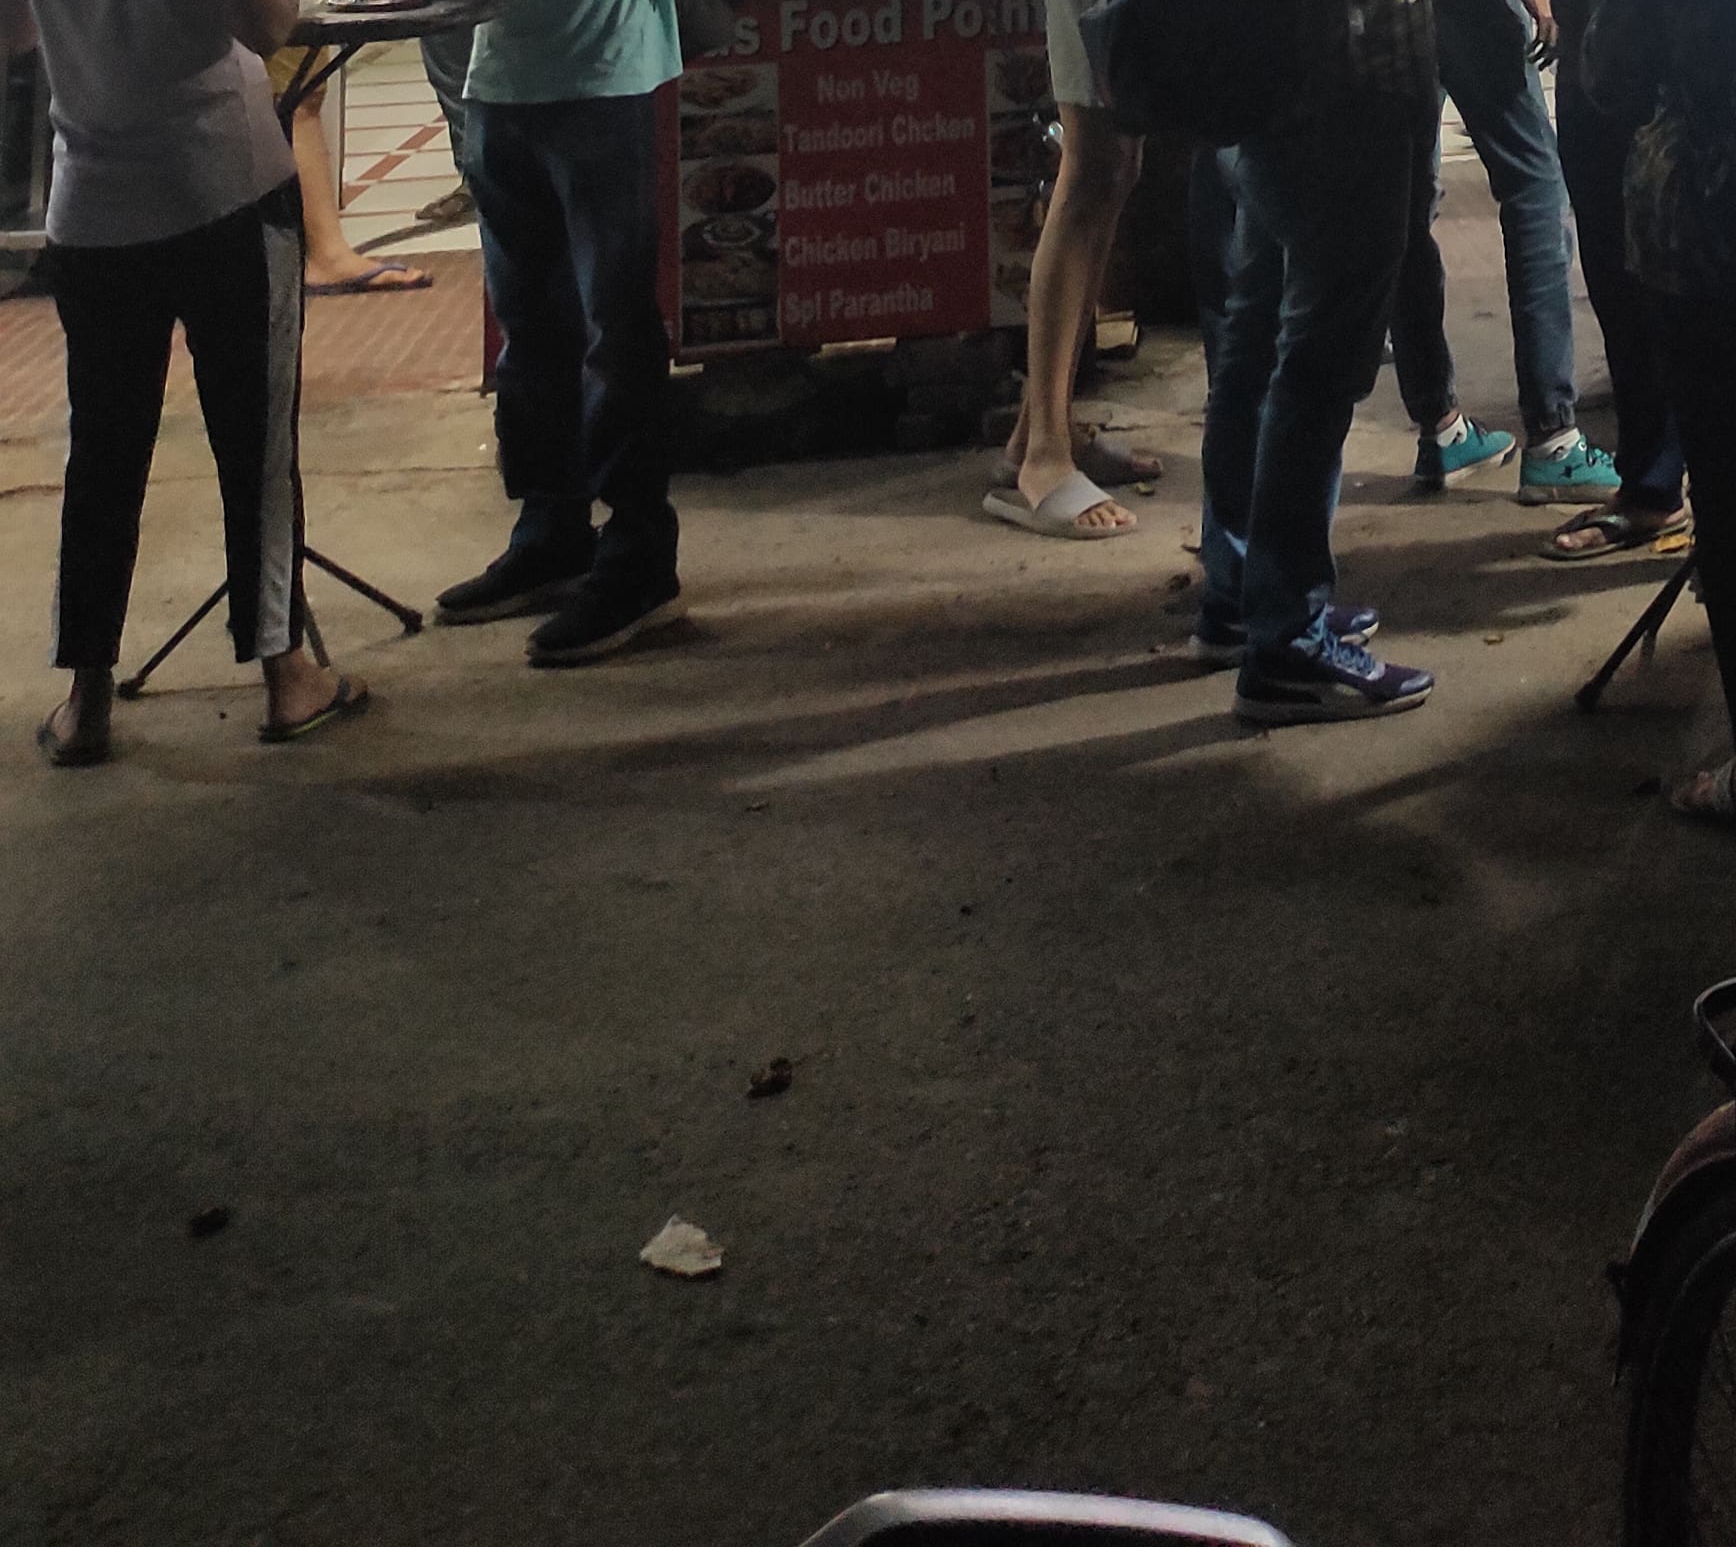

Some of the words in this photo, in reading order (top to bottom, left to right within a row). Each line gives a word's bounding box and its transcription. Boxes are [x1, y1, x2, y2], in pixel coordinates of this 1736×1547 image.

[817, 74, 865, 103] Non
[873, 69, 920, 102] Veg
[785, 179, 857, 211] Butter
